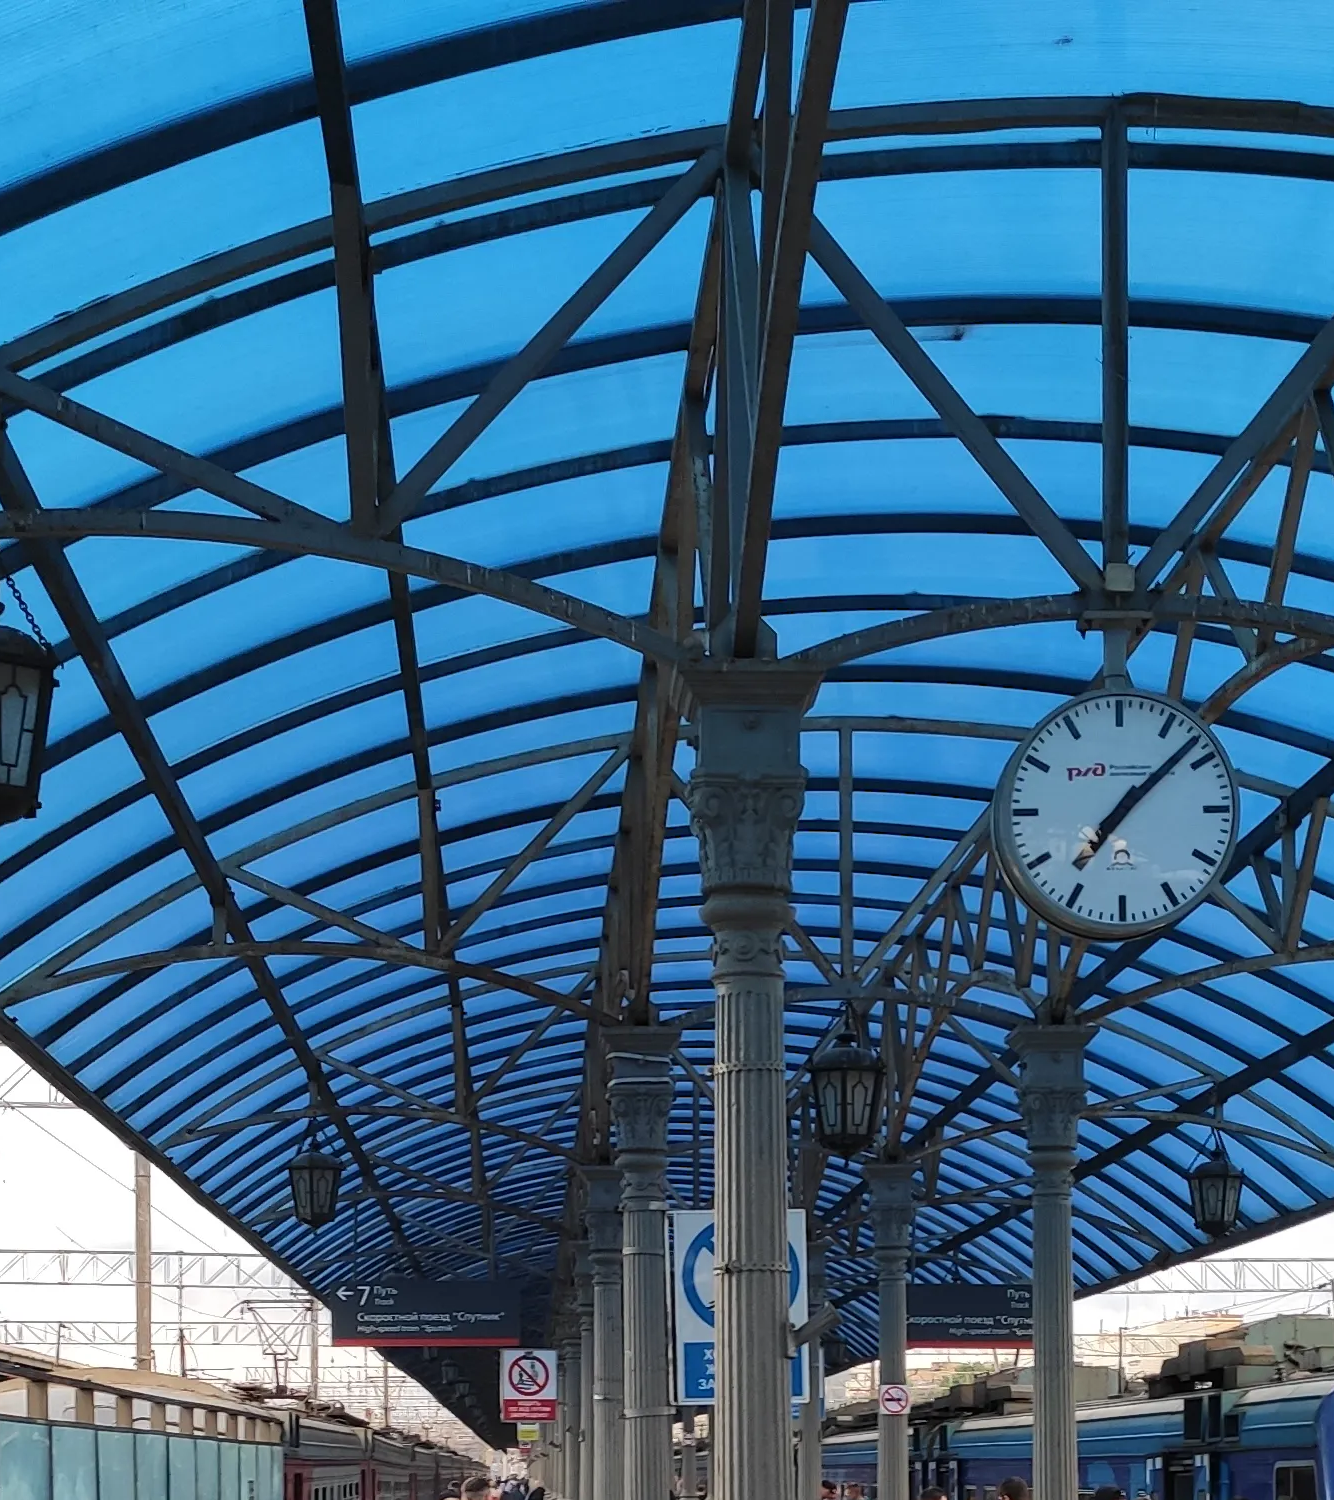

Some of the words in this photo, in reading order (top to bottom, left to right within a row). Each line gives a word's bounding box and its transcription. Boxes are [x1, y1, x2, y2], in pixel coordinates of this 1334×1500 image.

[356, 1285, 371, 1306] 7
[373, 1285, 399, 1297] Путь
[1007, 1289, 1031, 1300] Путь
[356, 1311, 419, 1324] Скоростной
[419, 1314, 451, 1322] поезд
[964, 1316, 994, 1325] поезд
